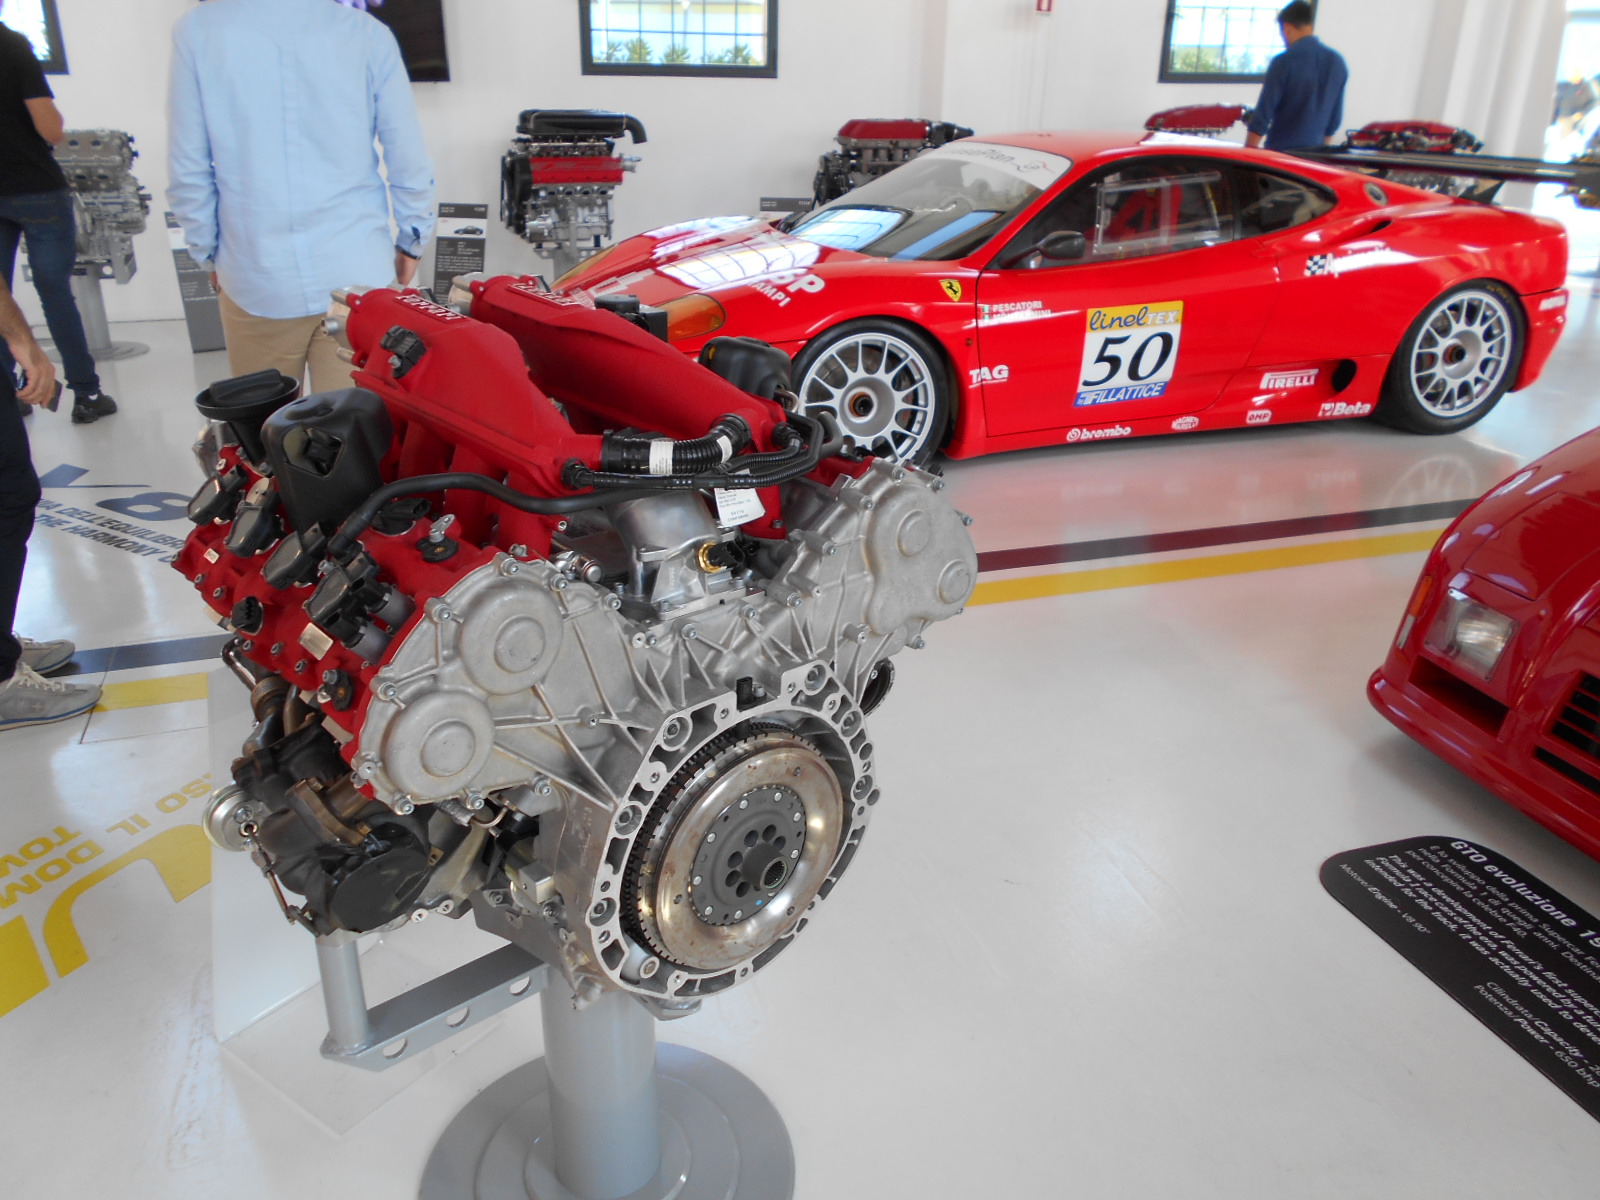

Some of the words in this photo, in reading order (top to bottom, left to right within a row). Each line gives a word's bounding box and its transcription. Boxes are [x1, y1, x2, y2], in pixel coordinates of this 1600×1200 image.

[992, 301, 1043, 313] PESCATORI
[969, 365, 1009, 384] TAG
[1082, 331, 1174, 387] 50
[1090, 382, 1165, 404] FILLATTICE
[1259, 368, 1319, 390] PIRELLI
[1080, 424, 1132, 440] brembo
[1333, 401, 1372, 416] Beta
[60, 524, 168, 557] HARMONY
[1339, 863, 1399, 910] Motore/Engine
[1401, 912, 1416, 923] V8
[1404, 850, 1425, 862] per
[1421, 860, 1465, 892] concepire
[1462, 889, 1474, 899] la
[1471, 896, 1508, 924] celebre
[1505, 921, 1528, 939] F40.
[1417, 847, 1441, 863] nella
[1439, 863, 1479, 890] Formula
[1487, 897, 1503, 907] di
[1499, 906, 1534, 930] quegli
[1532, 930, 1559, 951] anni.
[1560, 950, 1600, 984] Destina
[1447, 858, 1486, 885] sviluppo
[1485, 884, 1509, 902] della
[1507, 902, 1540, 923] prima
[1538, 922, 1586, 956] Supercar
[1450, 840, 1488, 863] GTO
[1484, 864, 1577, 927] evoluzione
[1364, 859, 1406, 888] intended
[1399, 887, 1418, 899] for
[1414, 898, 1434, 912] the
[1458, 932, 1473, 941] it
[1468, 940, 1491, 956] was
[1487, 955, 1534, 988] actually
[1530, 988, 1563, 1010] used
[1558, 1009, 1575, 1021] to
[1572, 1021, 1600, 1047] deve
[1374, 856, 1413, 883] Formula
[1414, 887, 1439, 902] race
[1433, 901, 1458, 918] cars
[1453, 914, 1470, 926] of
[1462, 922, 1483, 938] the
[1478, 934, 1499, 951] era,
[1498, 949, 1522, 967] was
[1514, 964, 1568, 999] powered
[1560, 998, 1579, 1010] by
[1581, 1014, 1600, 1033] tur
[1387, 854, 1409, 869] This
[1406, 868, 1426, 882] was
[1431, 887, 1493, 931] development
[1487, 930, 1507, 940] of
[1500, 938, 1545, 971] Ferrari's
[1541, 970, 1569, 988] first
[1564, 988, 1600, 1020] superc
[1473, 984, 1551, 1044] Potenza/Power
[1553, 1049, 1579, 1069] 650
[1574, 1066, 1600, 1089] bhp
[1486, 981, 1585, 1058] Cilindrata/Capacity
